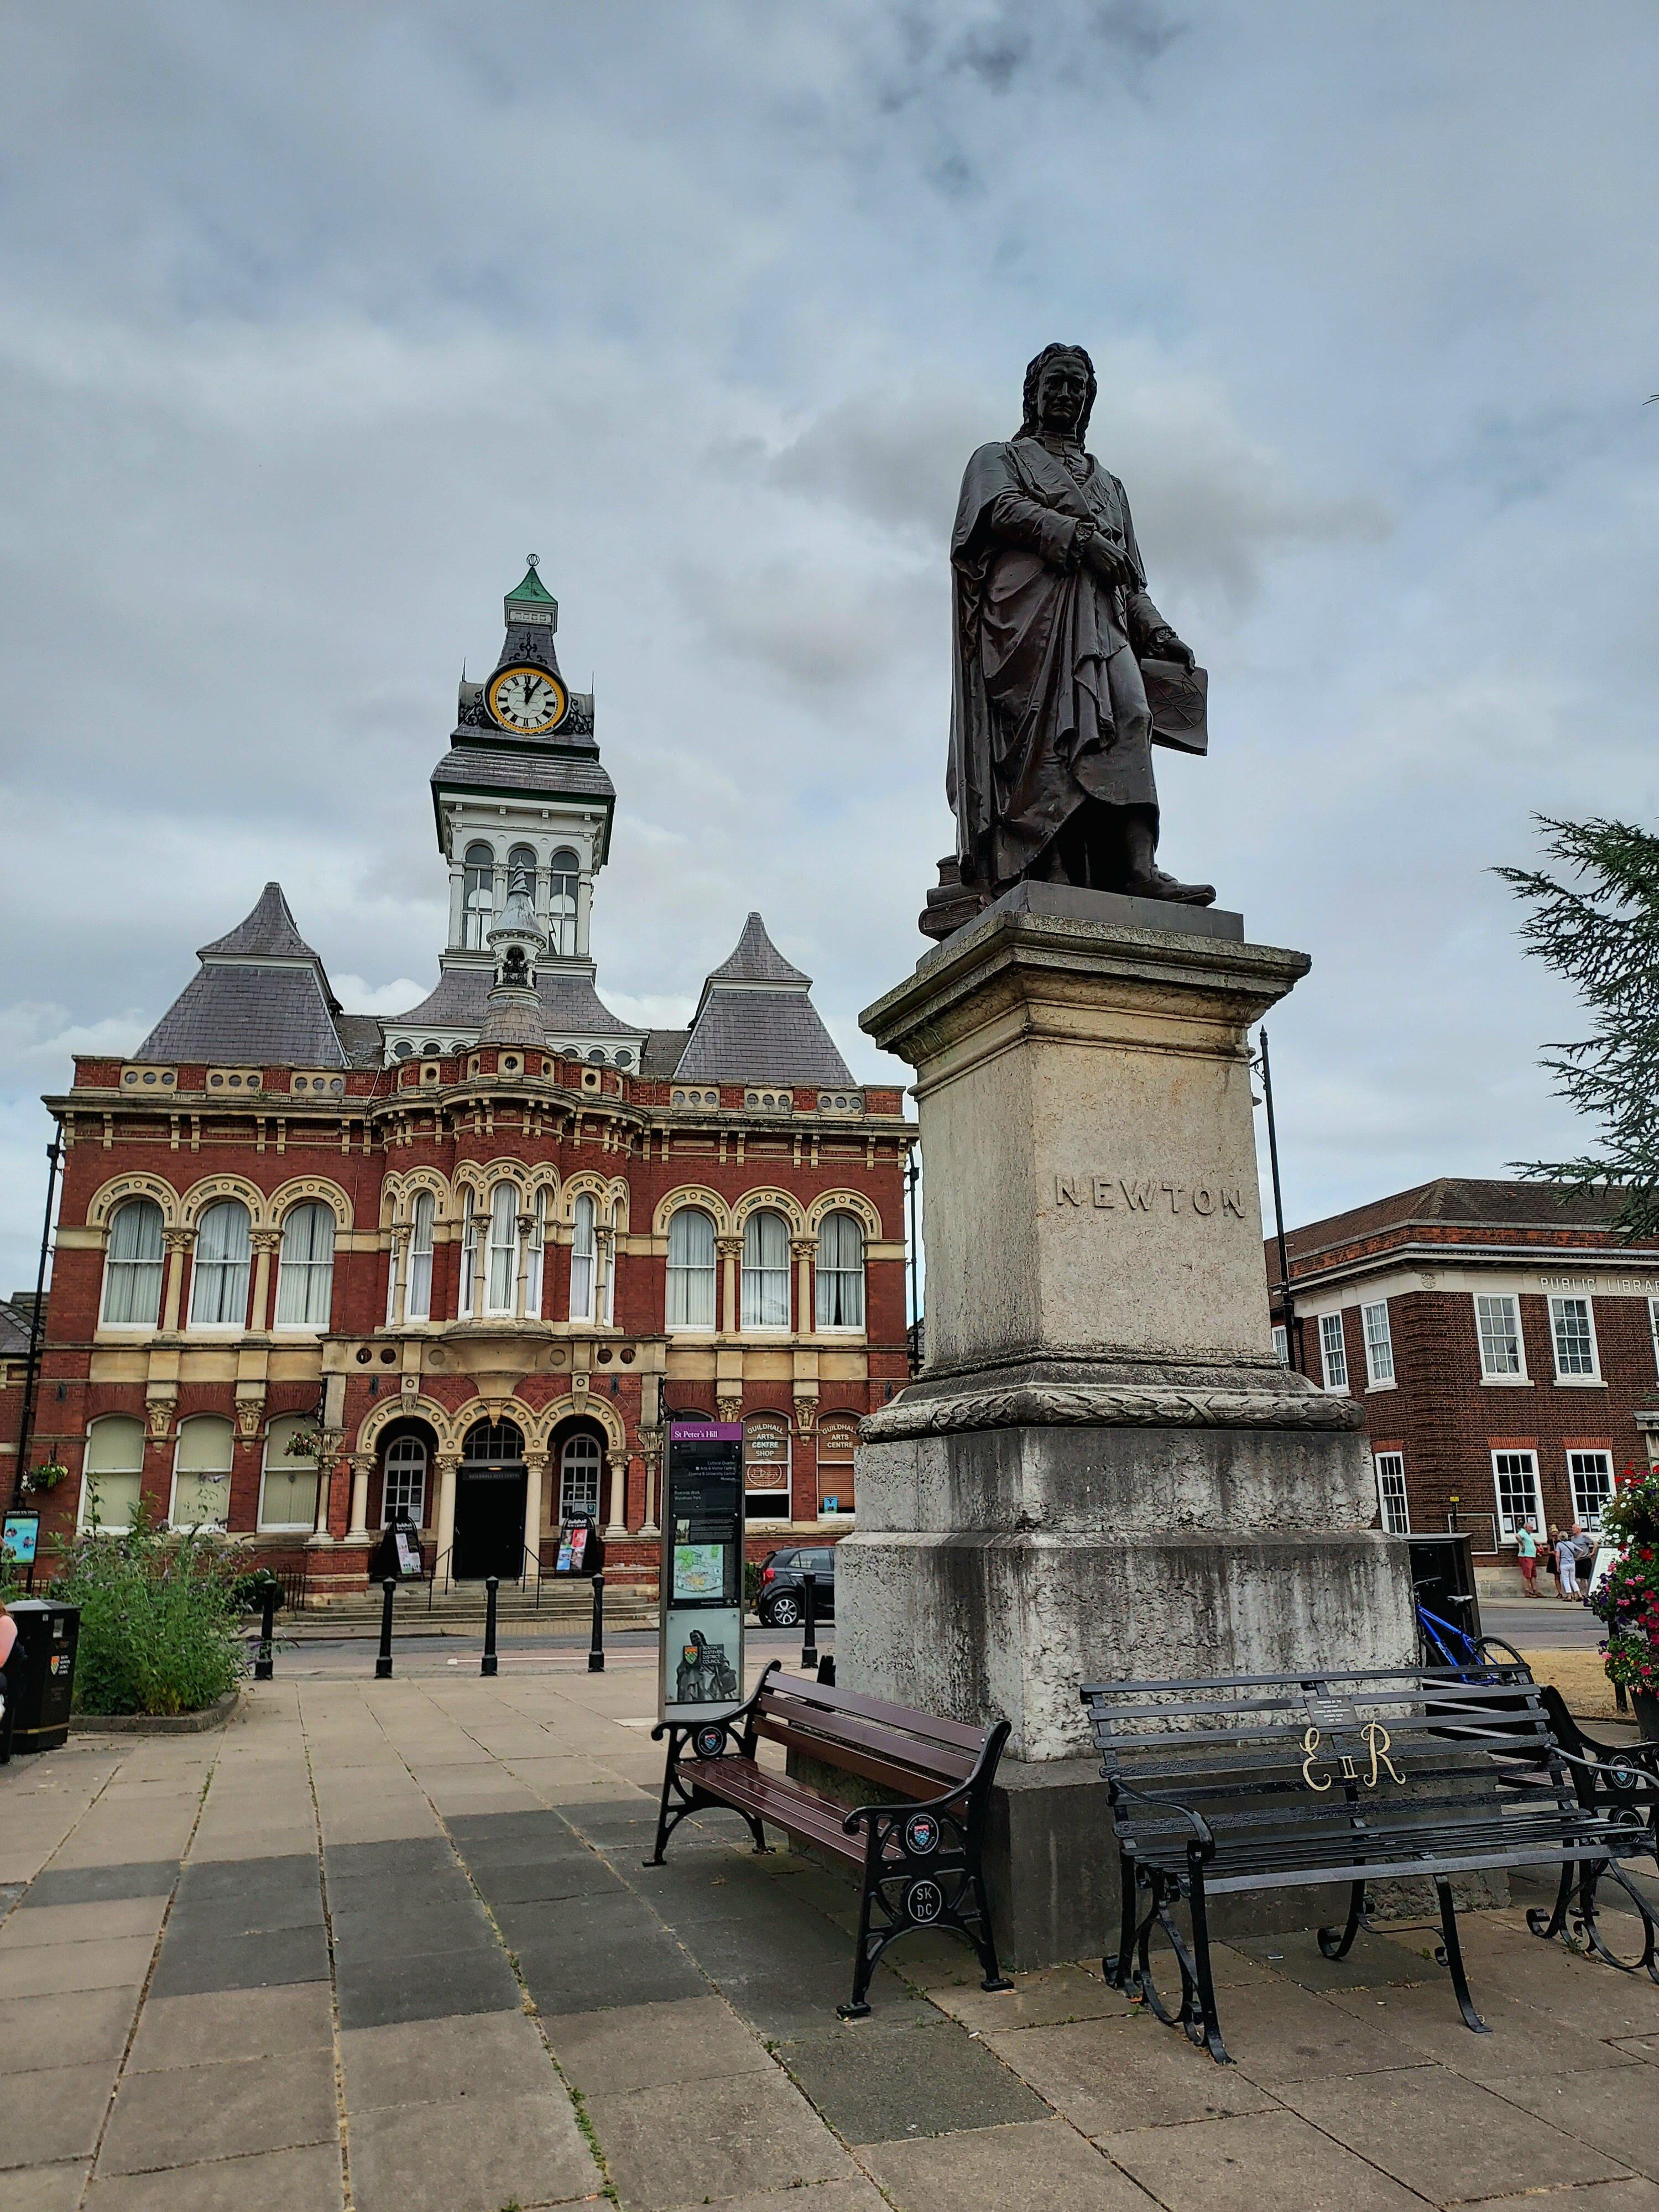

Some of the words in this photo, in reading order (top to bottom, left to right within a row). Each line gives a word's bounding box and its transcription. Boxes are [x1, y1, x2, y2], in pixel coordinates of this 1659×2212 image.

[1056, 1175, 1245, 1218] NEWTON
[1540, 1277, 1596, 1292] PUBLIC
[747, 1423, 783, 1434] GUILDHALL
[1299, 1727, 1332, 1791] E
[1360, 1720, 1406, 1787] R
[917, 1887, 932, 1900] SK
[917, 1903, 932, 1917] DC
